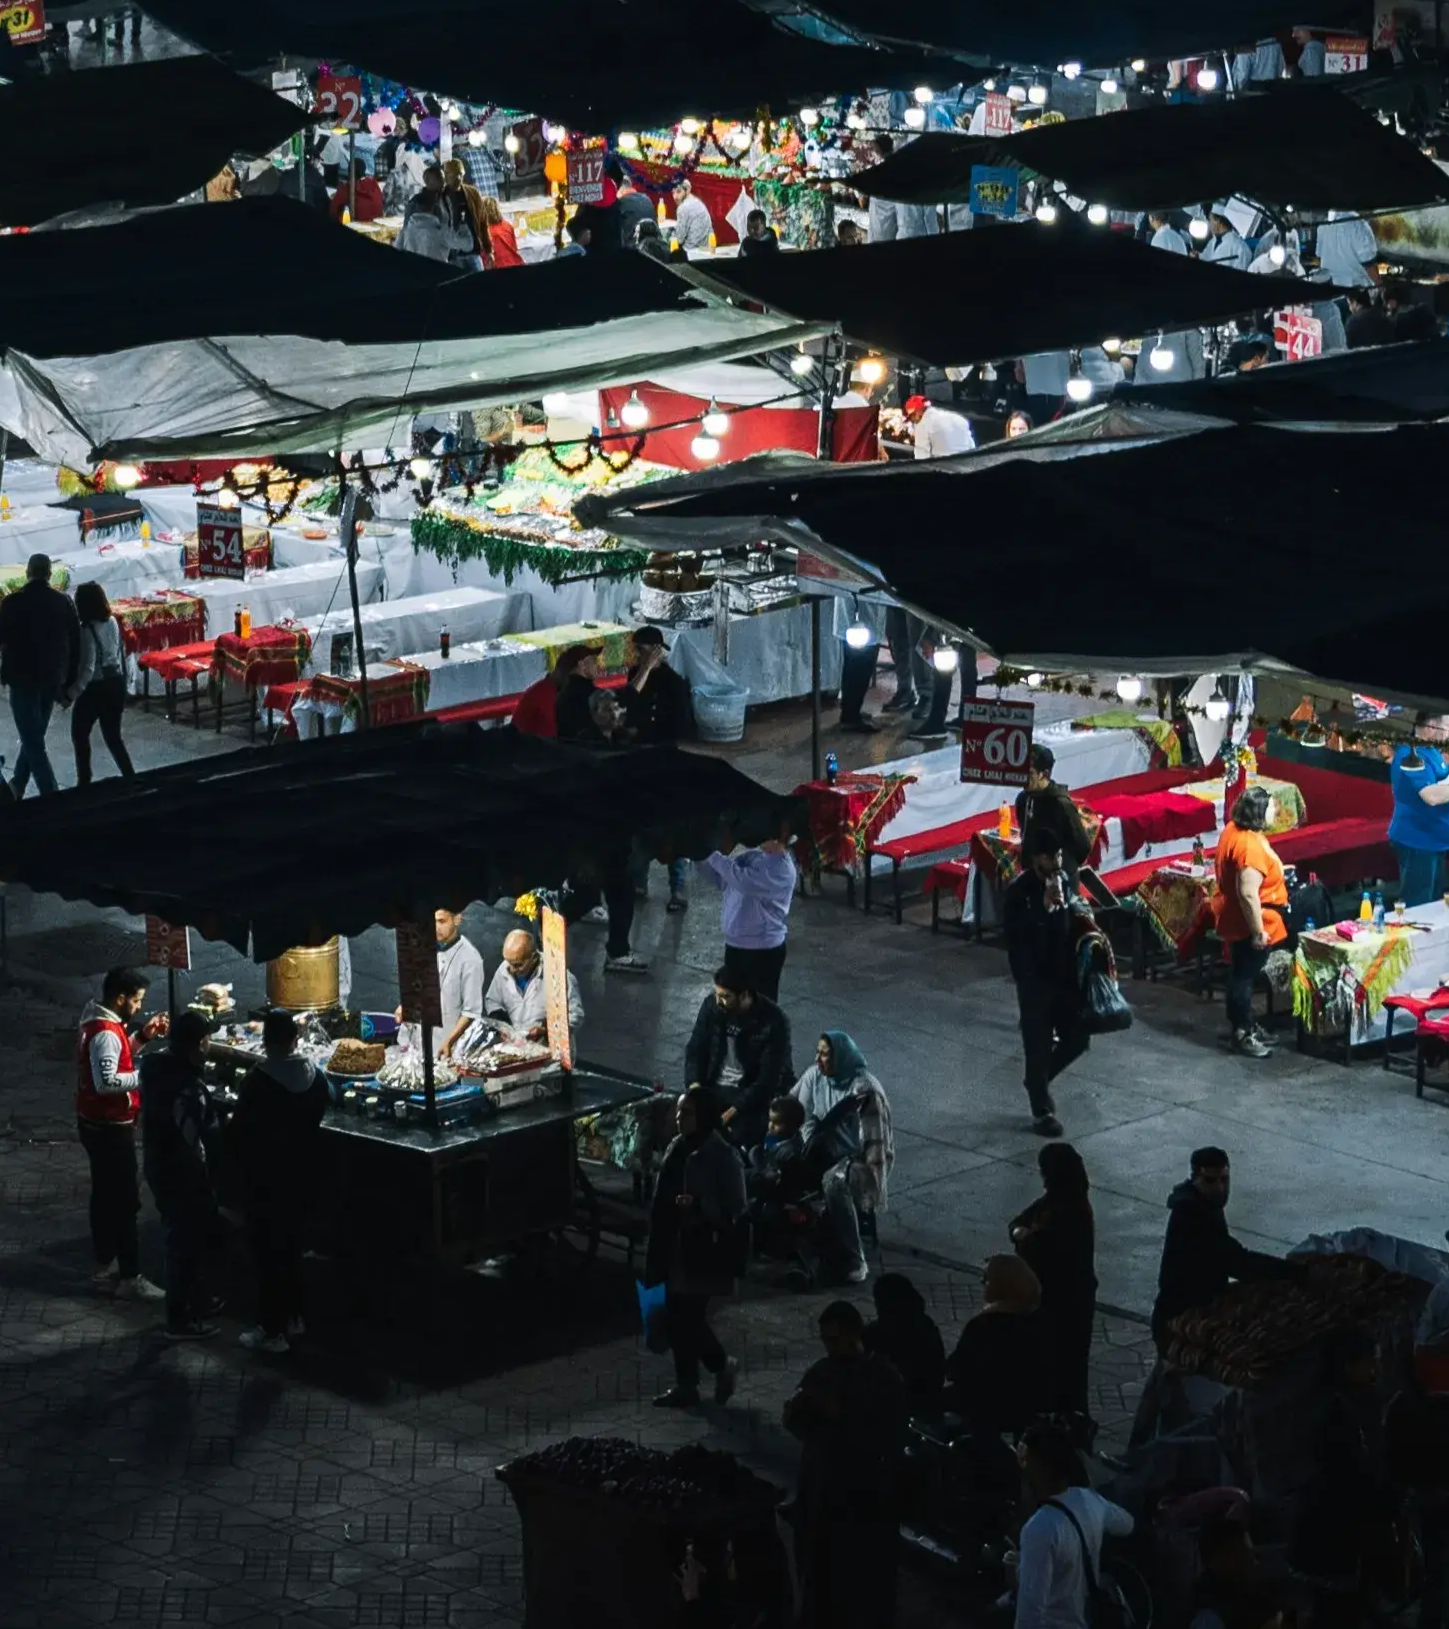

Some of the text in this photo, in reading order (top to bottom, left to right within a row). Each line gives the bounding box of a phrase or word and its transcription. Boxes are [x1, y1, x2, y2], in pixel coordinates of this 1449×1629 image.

[13, 9, 29, 26] 31
[1343, 55, 1361, 72] 31
[577, 160, 604, 183] 117
[1292, 331, 1314, 360] 44
[212, 528, 242, 563] 54
[983, 728, 1028, 767] 60
